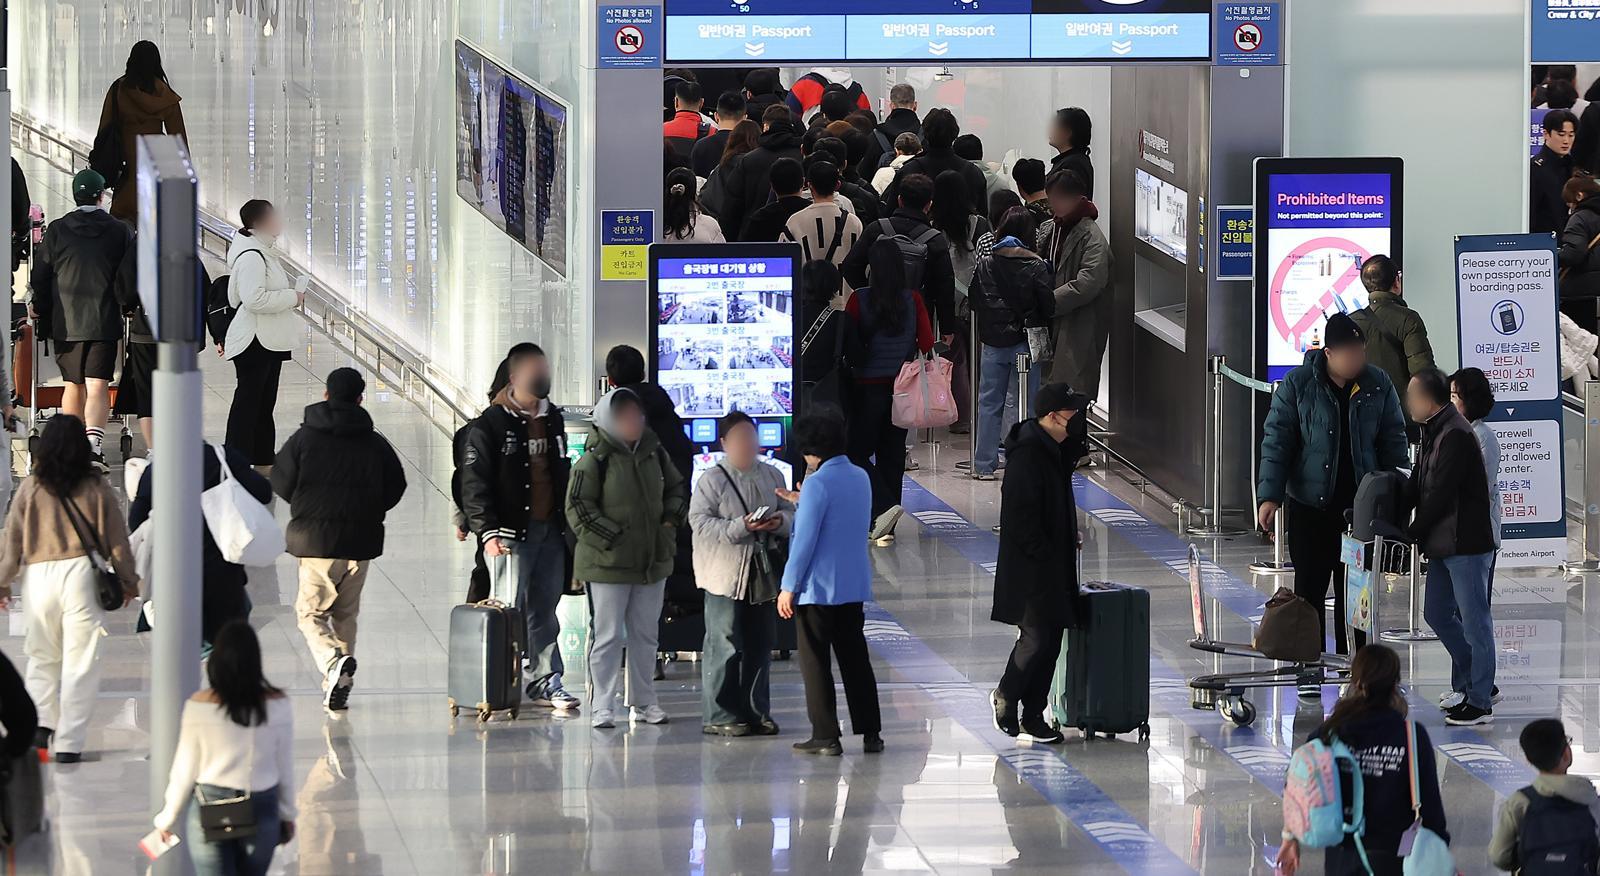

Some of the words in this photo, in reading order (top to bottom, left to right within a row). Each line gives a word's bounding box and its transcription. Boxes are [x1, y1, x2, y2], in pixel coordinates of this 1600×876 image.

[606, 9, 652, 18] 사진촬영금지
[1225, 6, 1271, 15] 사진촬영금지
[1547, 11, 1568, 19] Crew
[1569, 11, 1577, 19] &
[1578, 11, 1594, 20] City
[697, 24, 747, 38] 일반여권
[752, 24, 812, 39] Passport
[881, 23, 930, 38] 일반여권
[936, 24, 996, 38] Passport
[1065, 22, 1113, 37] 일반여권
[1119, 23, 1179, 37] Passport
[1277, 193, 1345, 205] Prohibited
[1347, 193, 1384, 205] Items
[617, 215, 640, 224] 환송객
[1290, 212, 1324, 220] permitted
[1325, 212, 1349, 221] beyond
[1349, 211, 1363, 219] this
[1363, 211, 1384, 220] point:
[612, 226, 644, 235] 진입불가
[1222, 232, 1253, 244] 진입불
[1462, 258, 1496, 267] Please
[1498, 259, 1525, 268] carry
[1527, 258, 1550, 267] your
[720, 263, 746, 274] 대기열
[1461, 271, 1483, 279] own
[1484, 270, 1529, 280] passport
[1531, 269, 1551, 277] and
[1469, 282, 1515, 292] boarding
[1517, 282, 1544, 291] pass.
[1475, 341, 1541, 353] 여권/탑승권은
[1493, 355, 1524, 366] 반드시
[1483, 369, 1512, 379] 본인이
[1515, 368, 1536, 378] 소지
[1490, 382, 1529, 392] 해주세요
[1500, 442, 1542, 452] sengers
[1499, 453, 1510, 462] ot
[1511, 451, 1551, 461] allowed
[1504, 465, 1533, 474] enter.
[1498, 480, 1531, 490] 환송객
[1502, 493, 1525, 503] 절대
[1530, 550, 1555, 559] Airport
